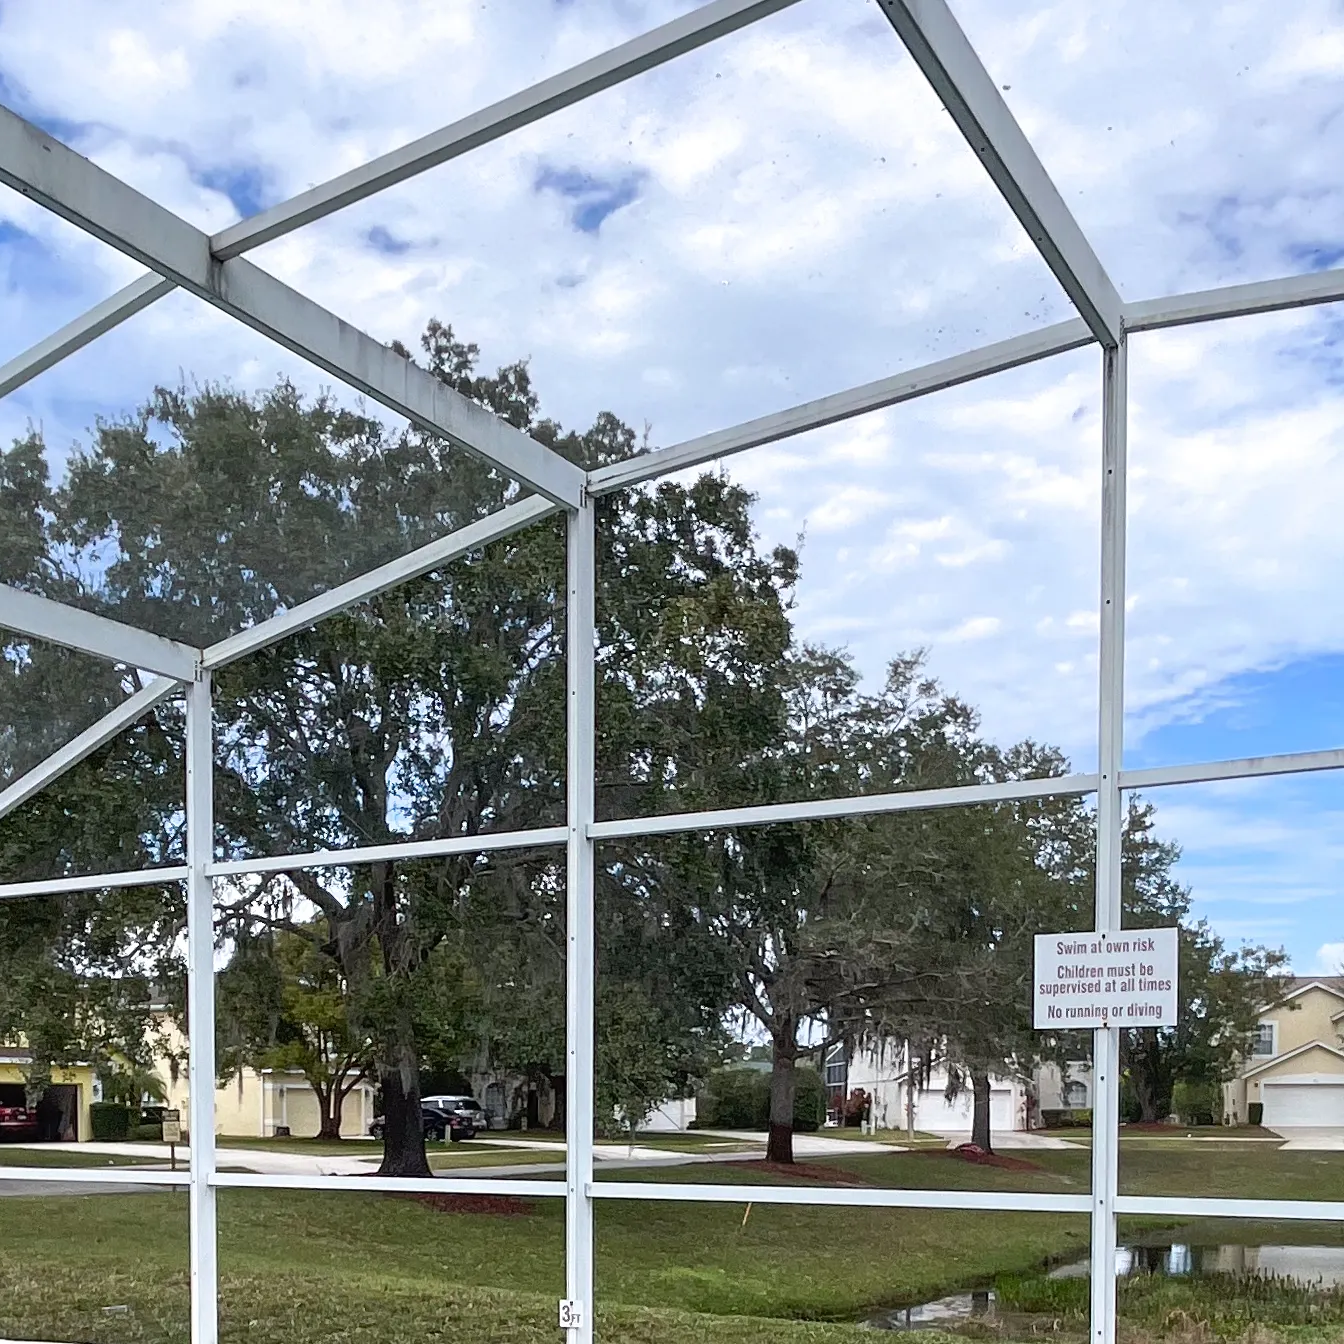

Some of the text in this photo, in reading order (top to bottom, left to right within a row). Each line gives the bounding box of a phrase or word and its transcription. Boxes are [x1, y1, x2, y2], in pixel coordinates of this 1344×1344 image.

[1057, 938, 1155, 955] Swim at own risk
[1057, 962, 1154, 979] Children must be
[1039, 978, 1172, 997] supervised at all times
[1047, 1002, 1162, 1020] No running or diving
